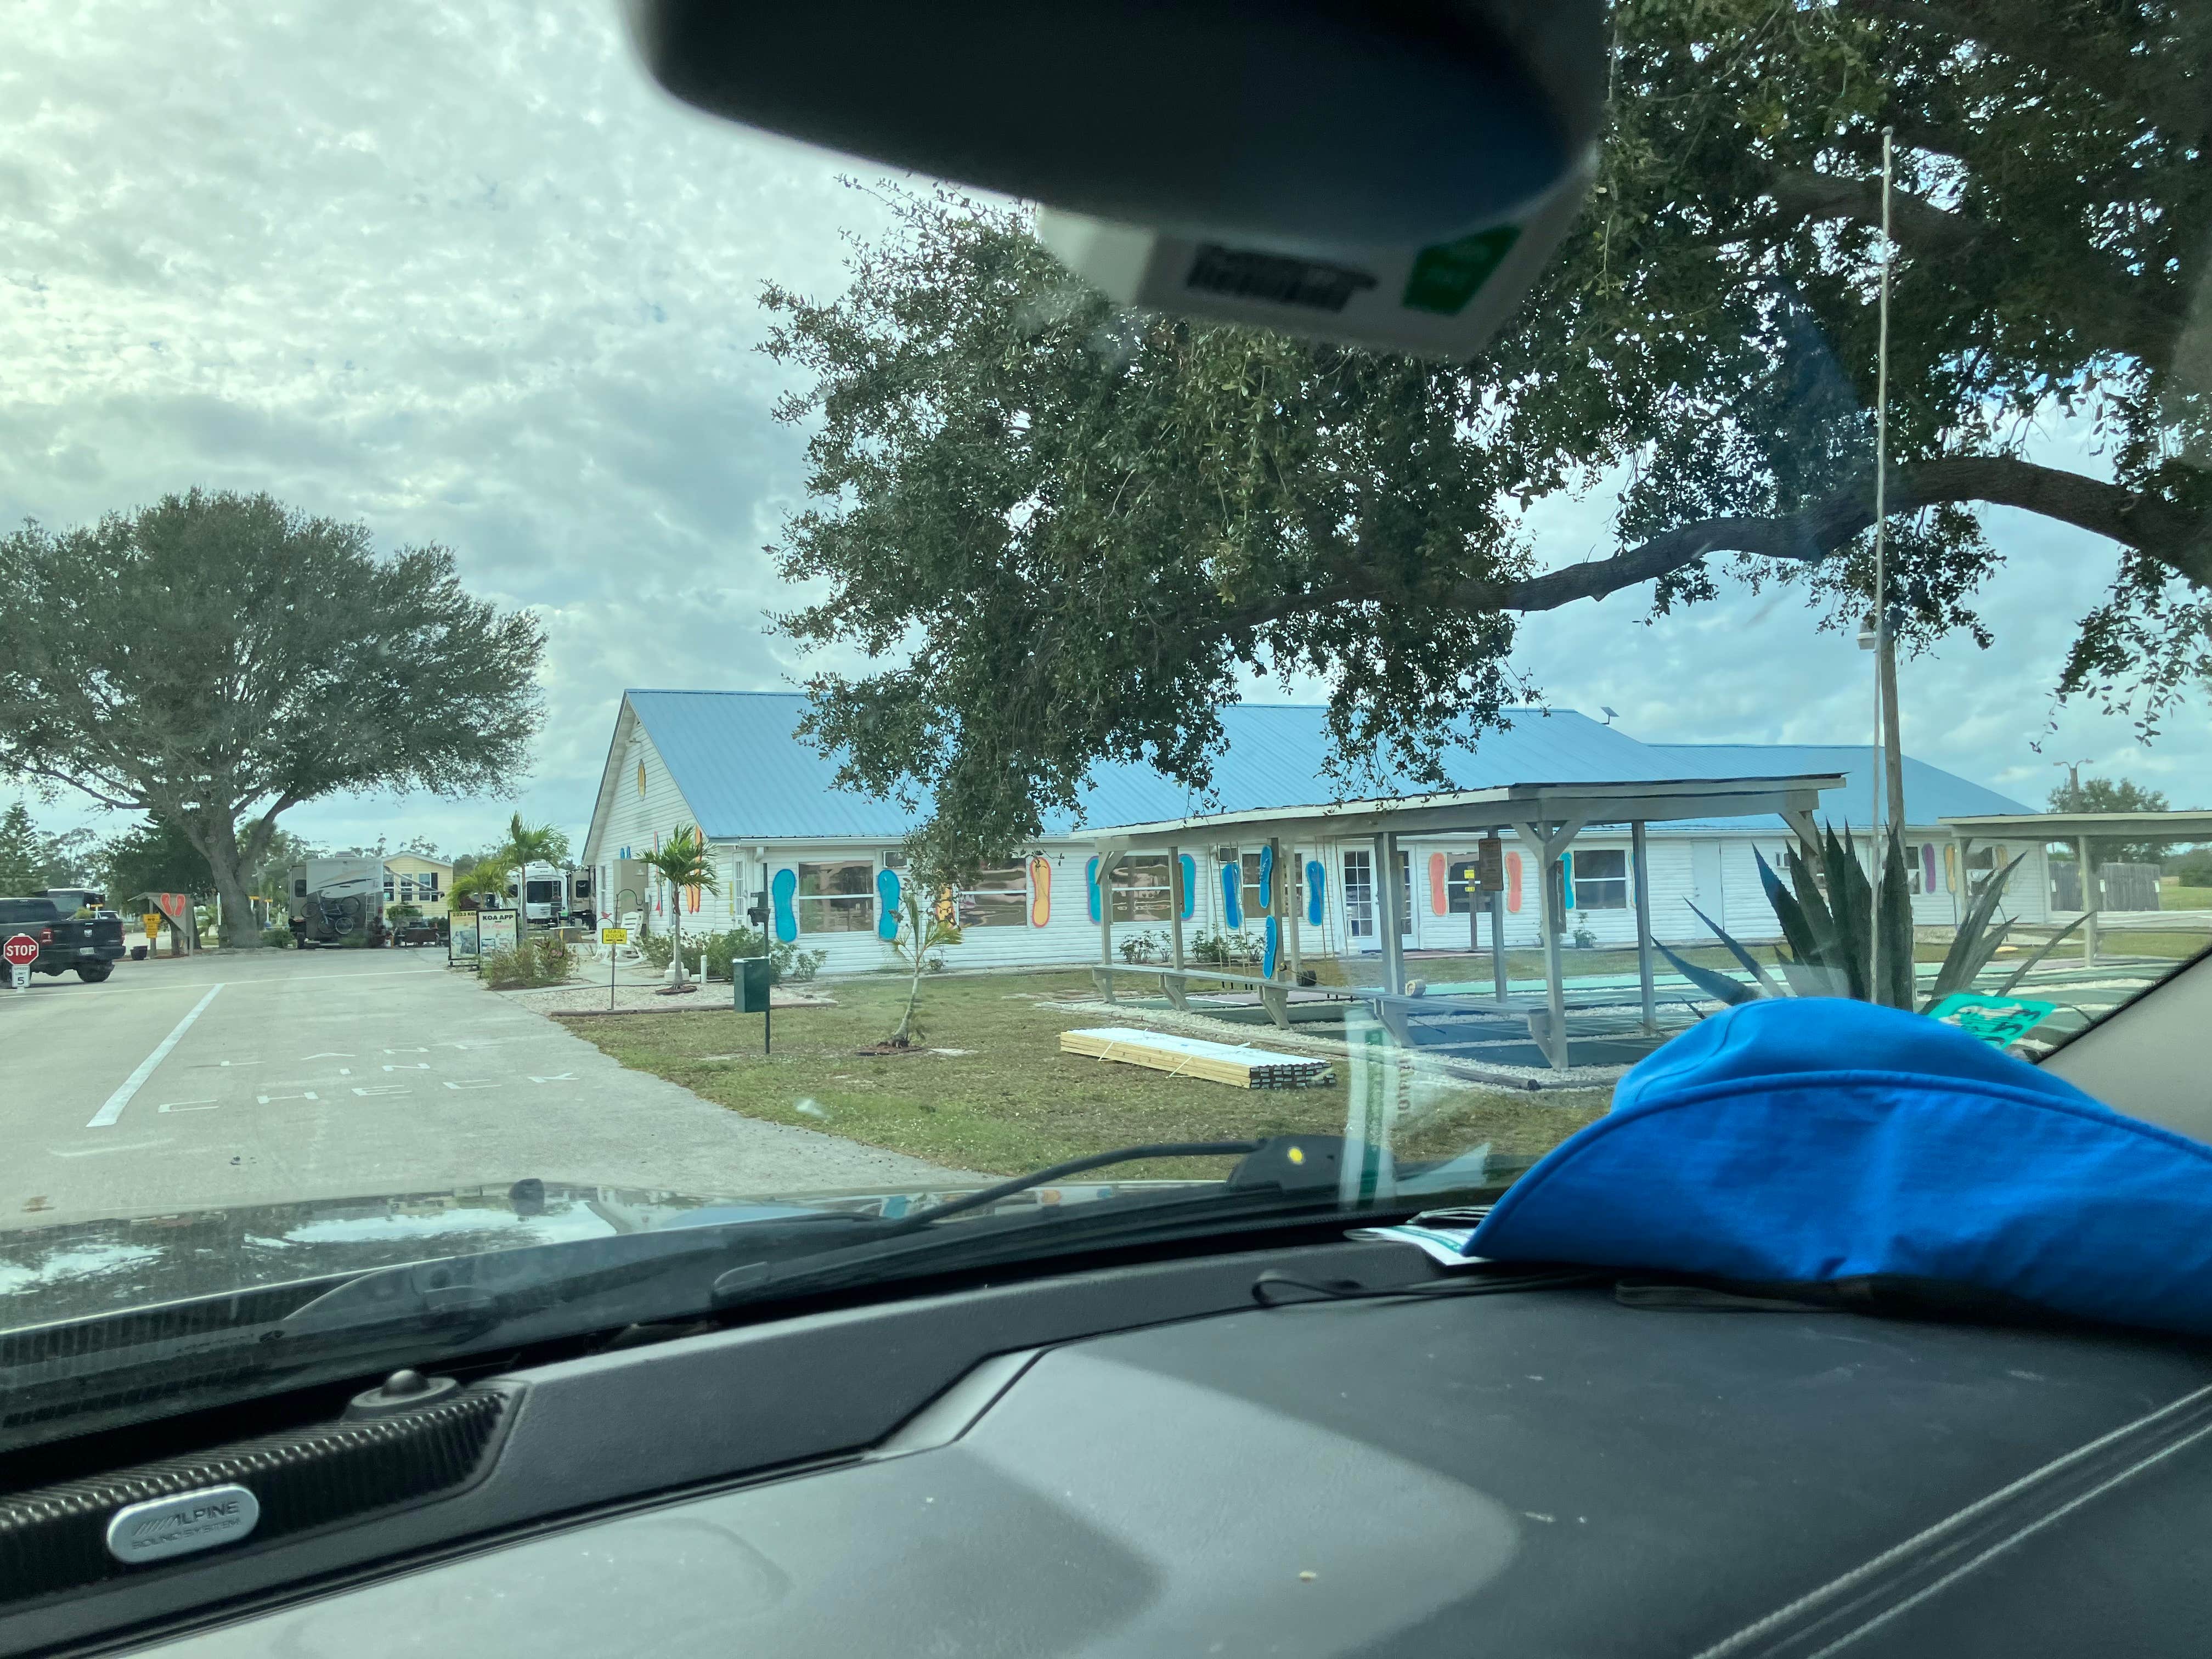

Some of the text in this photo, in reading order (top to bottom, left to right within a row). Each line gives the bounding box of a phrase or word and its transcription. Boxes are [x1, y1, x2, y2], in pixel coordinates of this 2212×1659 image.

[6, 945, 36, 956] STOP
[18, 977, 25, 985] 5
[165, 1500, 240, 1527] ALPINE
